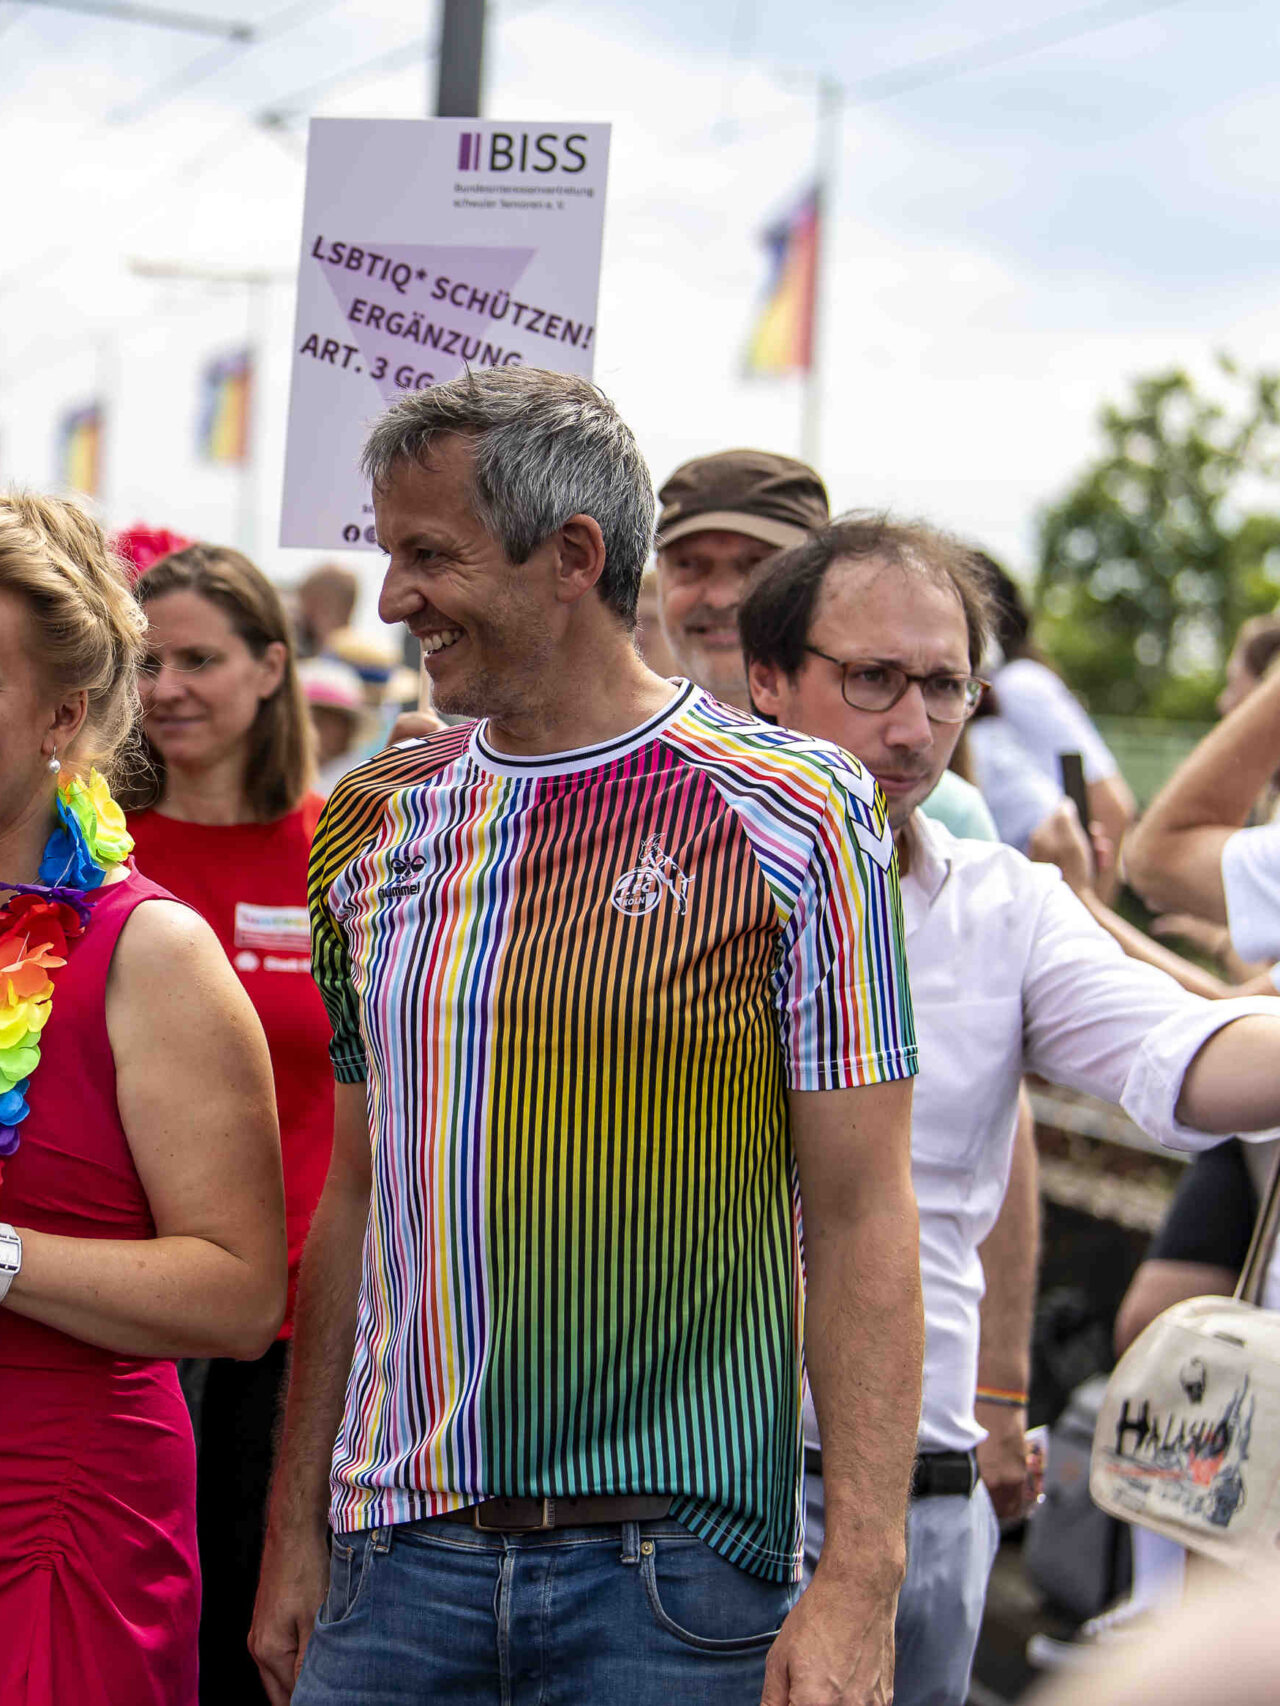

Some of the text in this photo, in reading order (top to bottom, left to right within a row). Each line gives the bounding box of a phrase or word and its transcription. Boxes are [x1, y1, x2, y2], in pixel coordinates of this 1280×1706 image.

[489, 133, 588, 173] BISS
[431, 275, 595, 350] SCHÜTZEN!
[300, 333, 363, 373] ART.
[370, 356, 389, 380] 3
[378, 881, 420, 898] hummel
